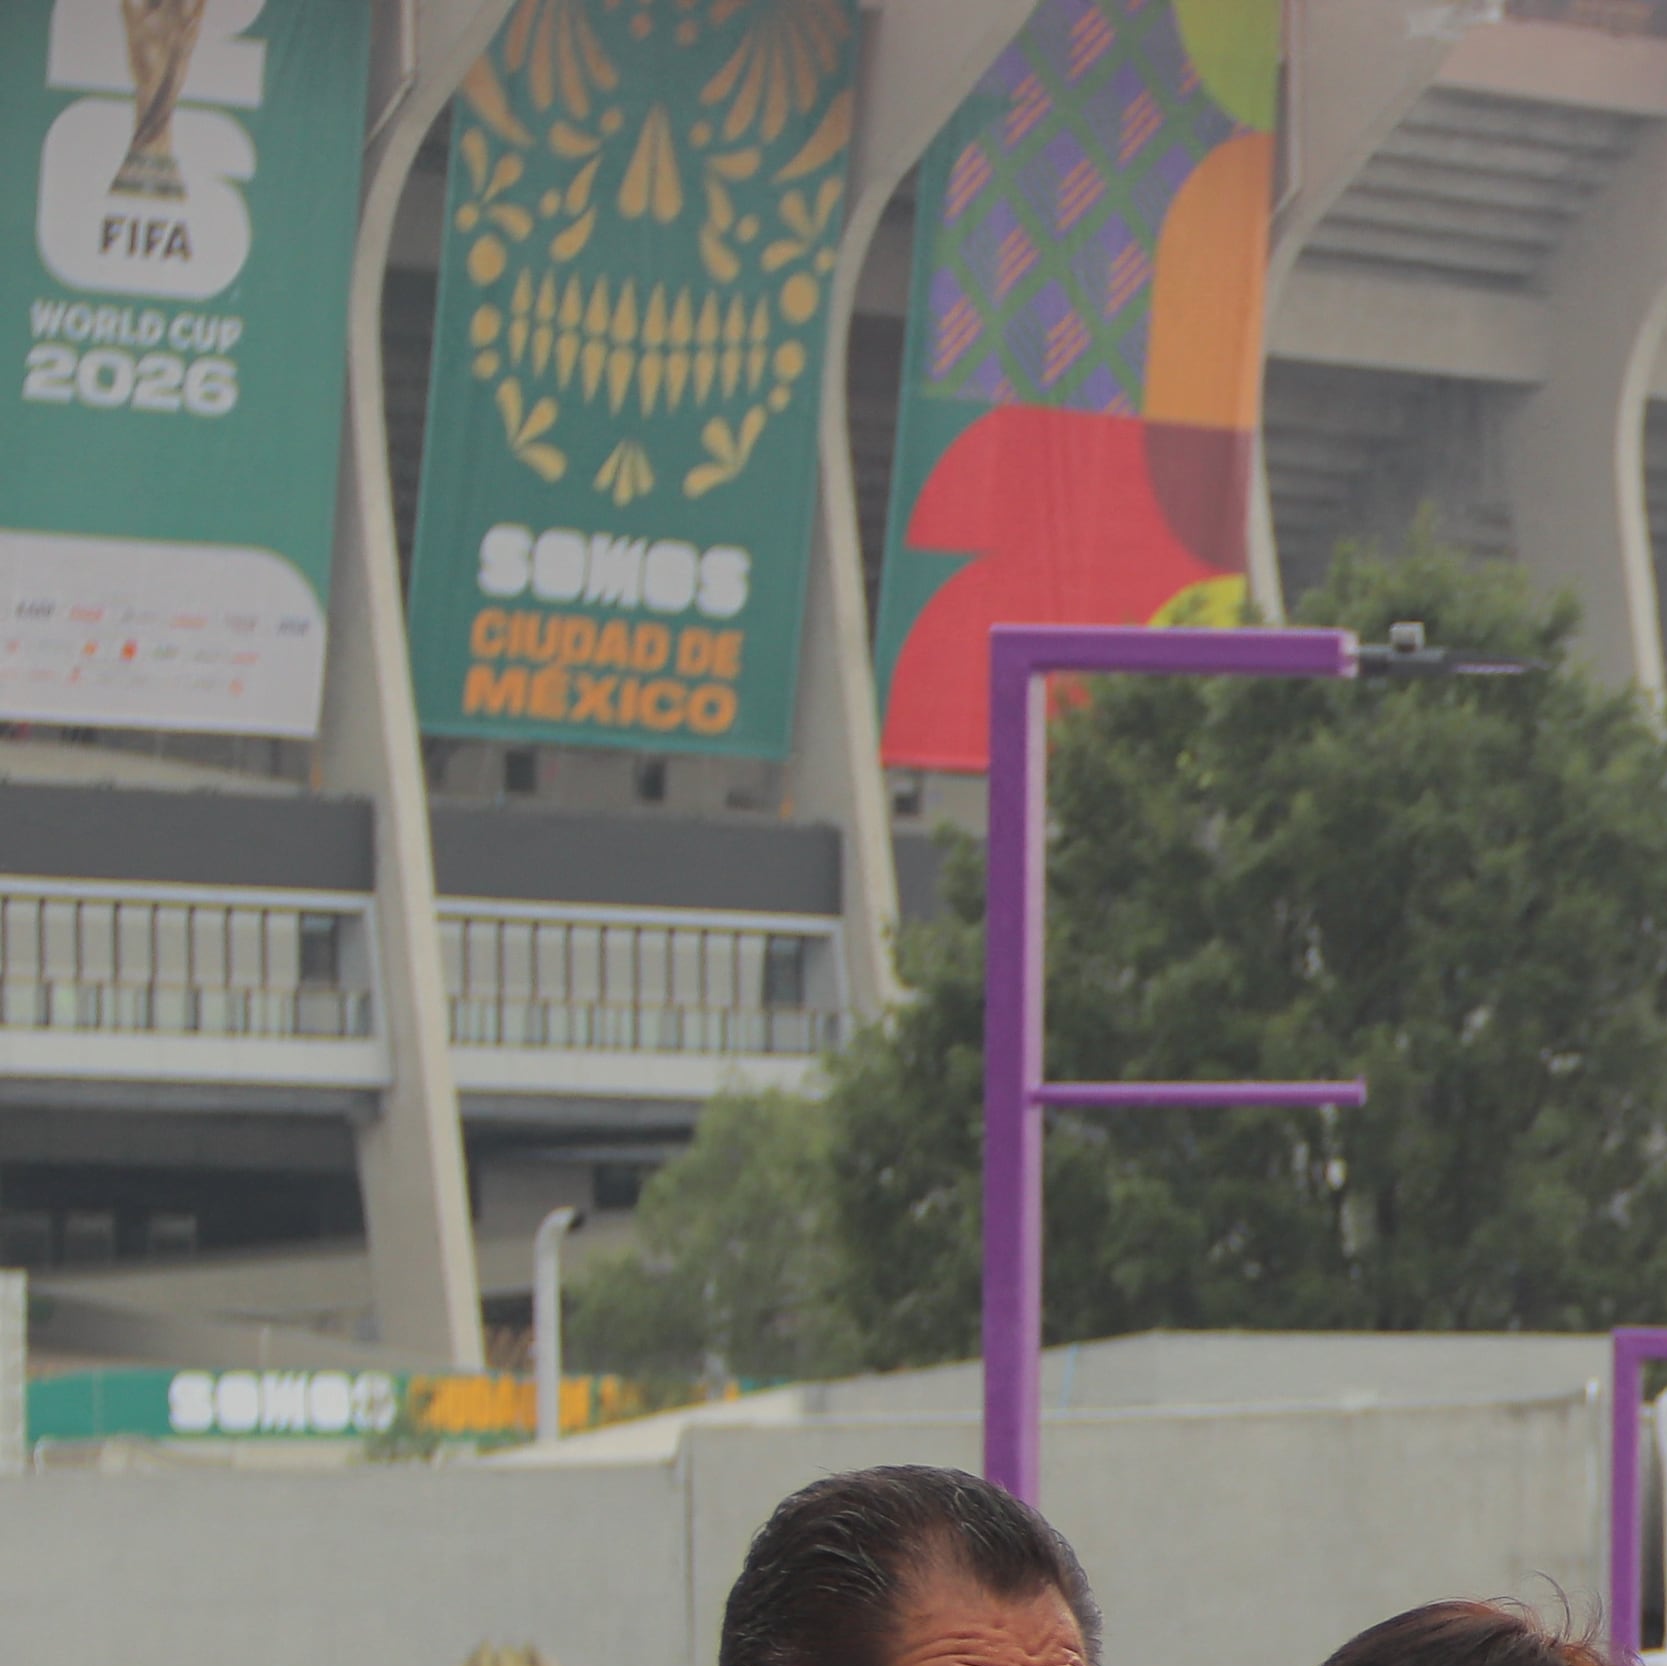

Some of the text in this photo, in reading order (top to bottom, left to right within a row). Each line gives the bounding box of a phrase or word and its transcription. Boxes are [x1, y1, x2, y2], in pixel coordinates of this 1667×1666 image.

[99, 214, 193, 262] FIFA
[29, 298, 244, 355] WORLD CUP
[23, 343, 238, 415] 2026
[479, 525, 750, 617] SOMOS
[470, 606, 744, 679] CIUDAD DE
[463, 661, 736, 735] MÉXICO
